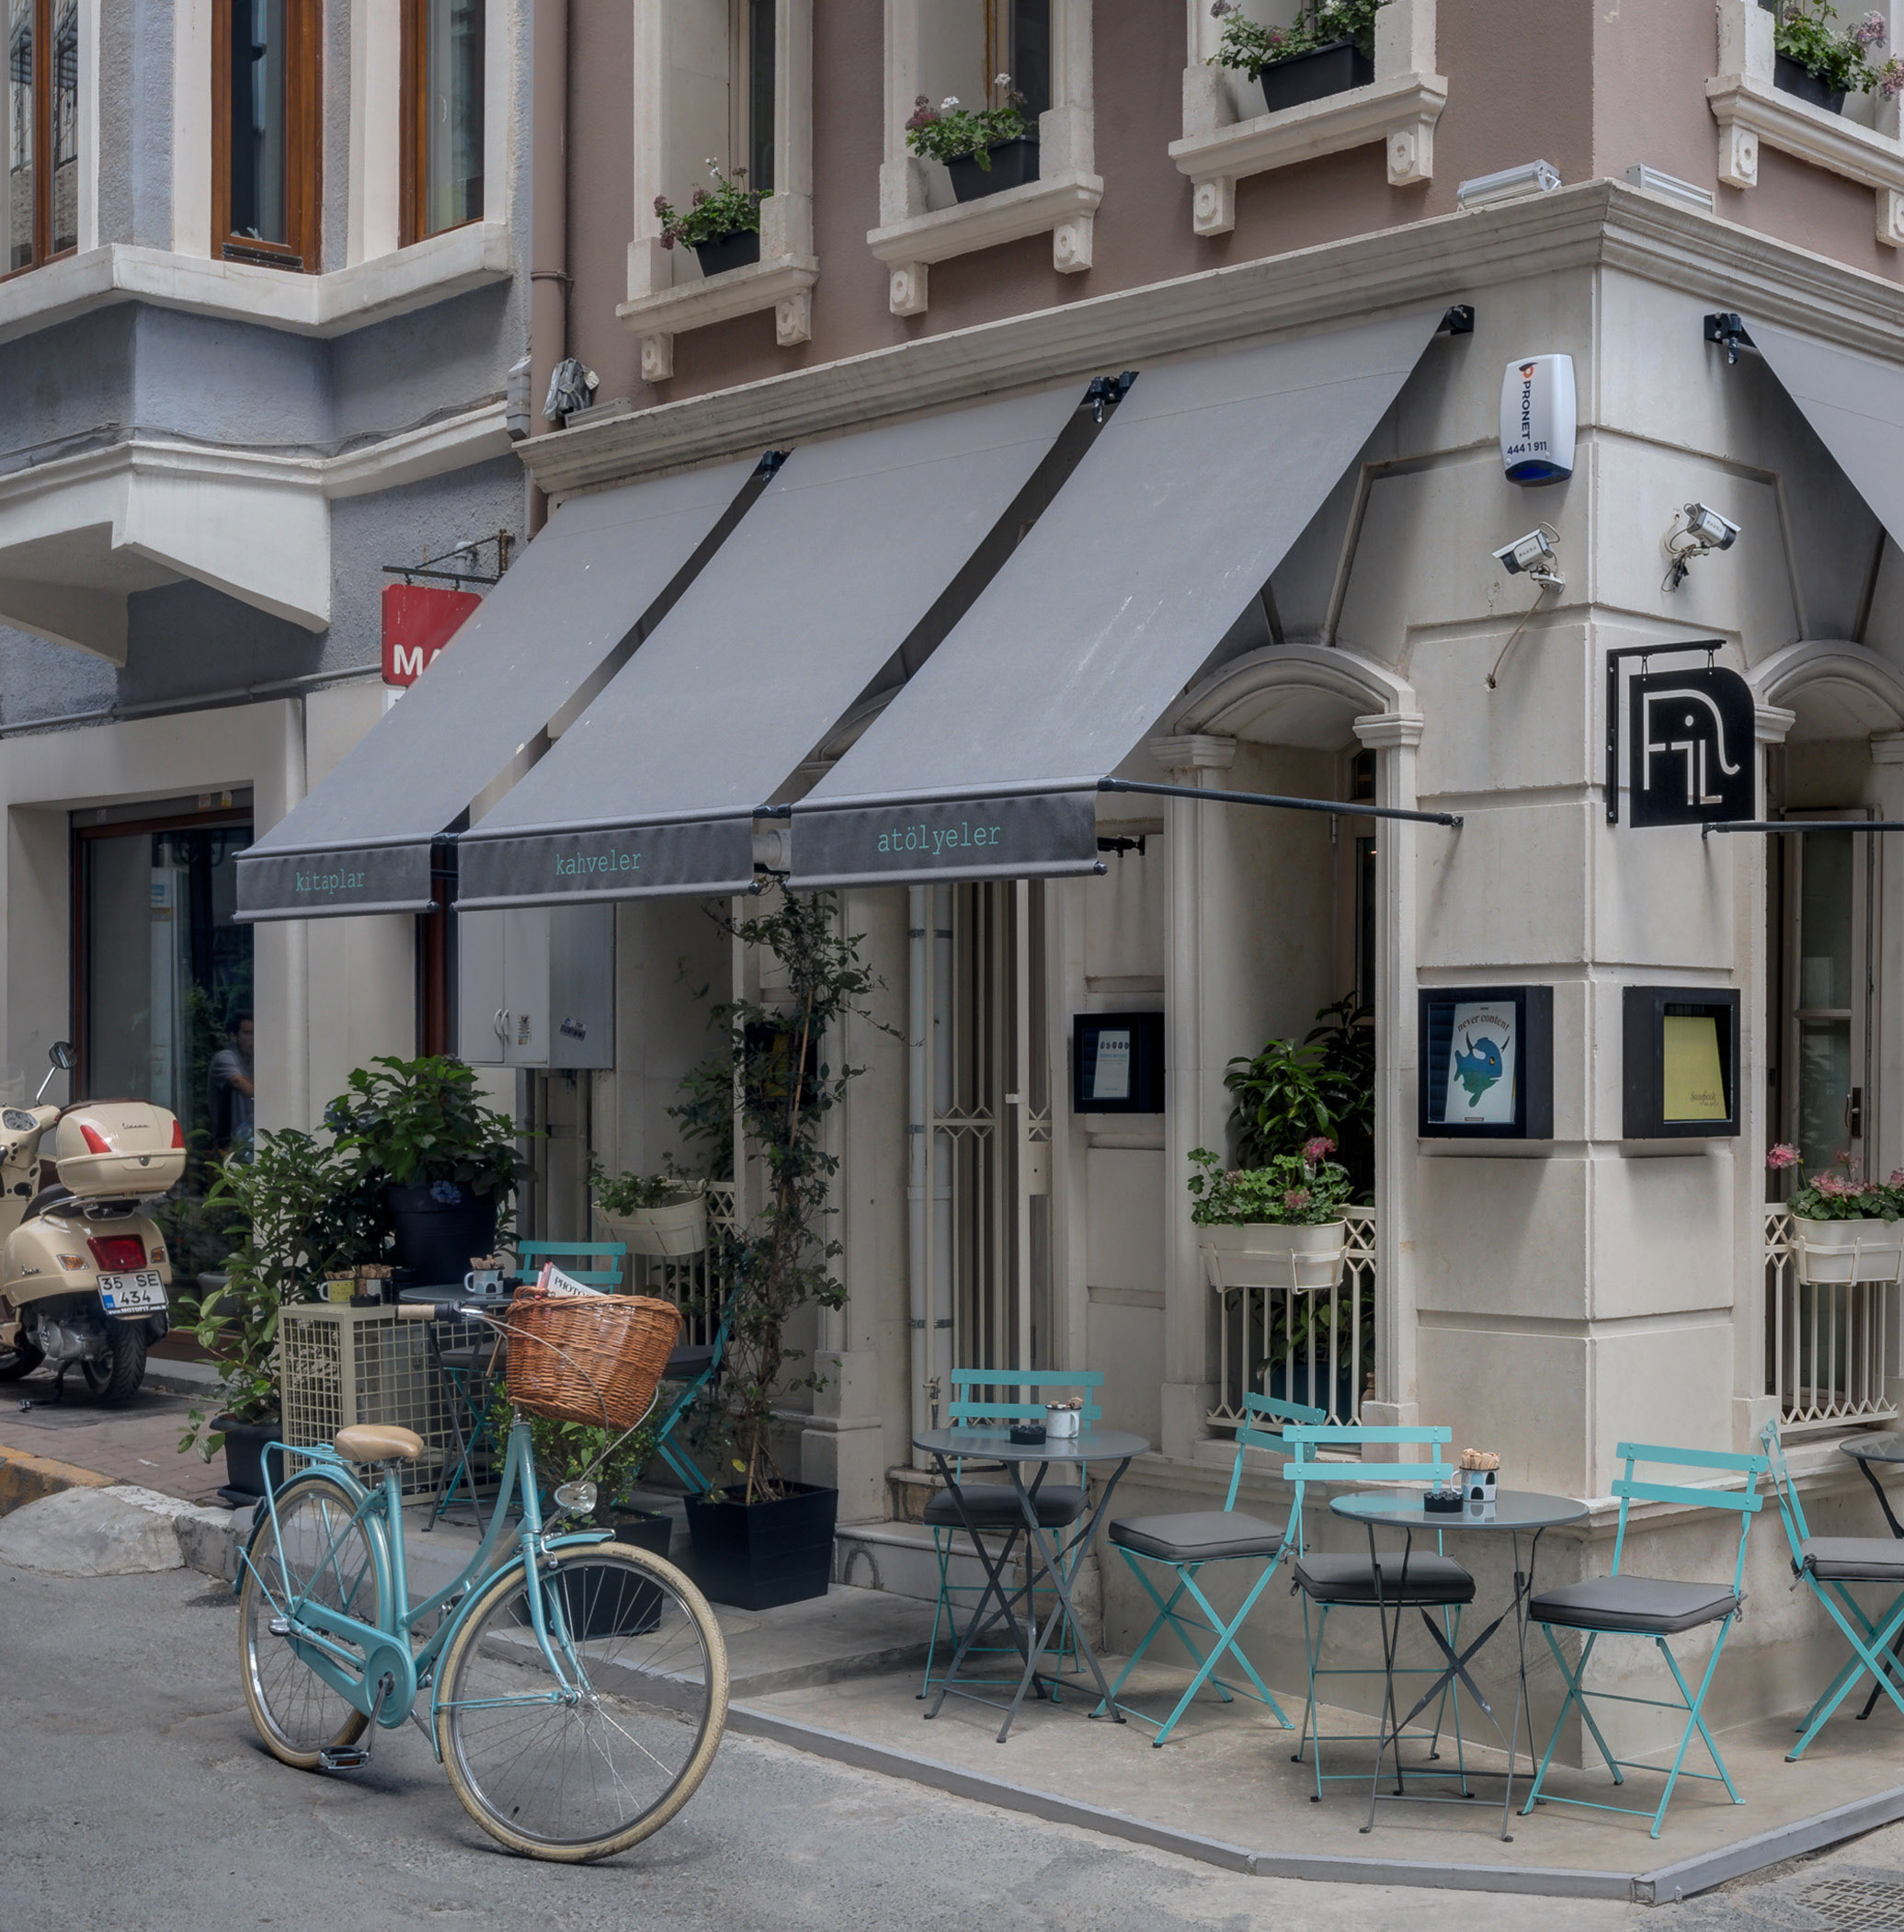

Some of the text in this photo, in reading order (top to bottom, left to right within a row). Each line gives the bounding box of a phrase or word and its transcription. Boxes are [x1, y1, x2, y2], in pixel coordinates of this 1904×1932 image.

[1522, 380, 1531, 440] PRONET
[1508, 441, 1547, 455] 444 1 911
[393, 644, 441, 676] M
[878, 821, 1001, 855] atölyeler
[556, 849, 642, 875] kahveler
[296, 868, 365, 895] kitaplar
[1457, 1013, 1511, 1033] never content
[101, 1274, 159, 1290] 35 SE
[120, 1290, 152, 1305] 434
[1823, 1892, 1904, 1913] TELEF
